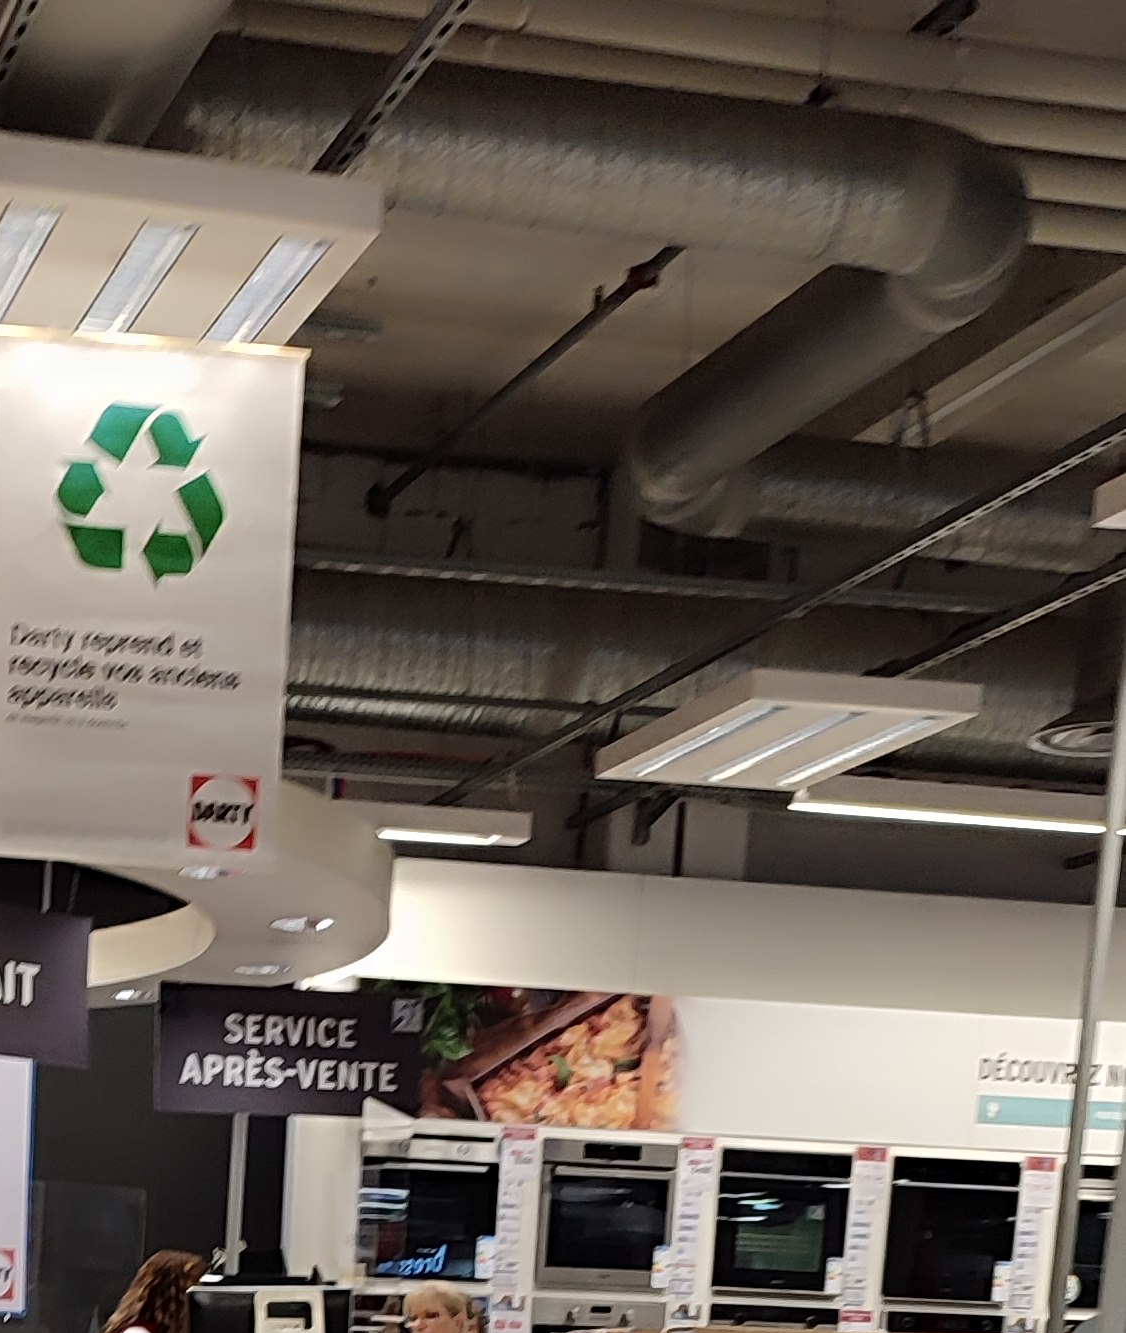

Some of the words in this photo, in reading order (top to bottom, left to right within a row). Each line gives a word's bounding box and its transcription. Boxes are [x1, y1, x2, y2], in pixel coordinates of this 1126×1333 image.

[10, 622, 74, 653] Darty
[80, 630, 174, 657] reprend
[9, 655, 96, 682] recycle
[102, 662, 144, 684] vos
[147, 662, 241, 690] anciens
[7, 685, 118, 710] appareils
[191, 802, 254, 825] DARTY
[224, 1012, 358, 1049] SERVICE
[178, 1049, 400, 1093] APRÈS-VENTE
